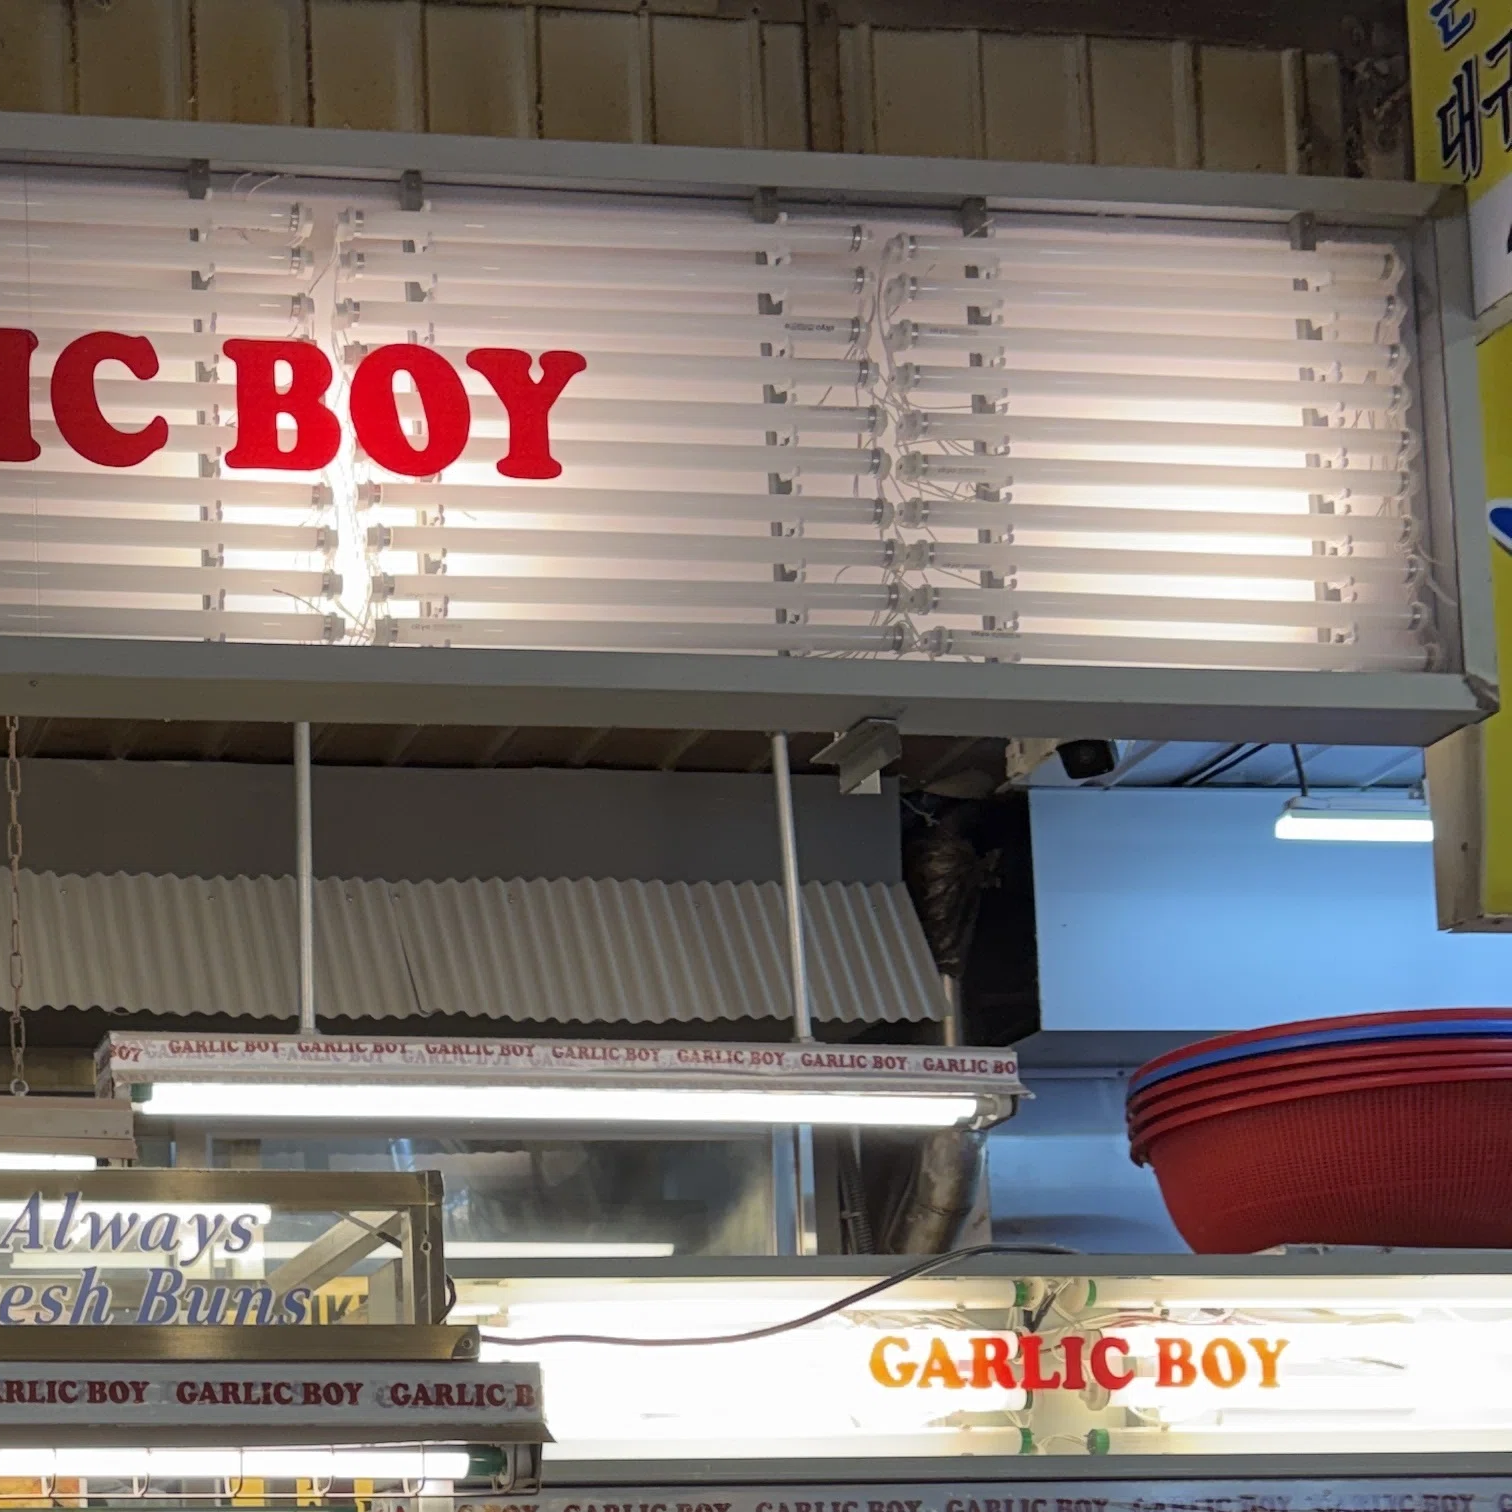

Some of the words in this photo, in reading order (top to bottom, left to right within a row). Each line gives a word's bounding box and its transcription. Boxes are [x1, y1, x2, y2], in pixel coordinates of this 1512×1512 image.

[223, 337, 588, 479] BOY
[168, 1040, 238, 1056] GARLIC
[245, 1039, 282, 1054] BOY
[372, 1042, 409, 1055] BOY
[500, 1044, 535, 1057] BOY
[551, 1046, 620, 1061] GARLIC
[625, 1048, 662, 1063] BOY
[677, 1048, 744, 1065] GARLIC
[750, 1052, 786, 1067] BOY
[800, 1053, 868, 1069] GARLIC
[872, 1056, 908, 1071] BOY
[923, 1057, 988, 1074] GARLIC
[992, 1060, 1017, 1075] BO
[137, 1267, 312, 1326] Buns
[870, 1335, 1136, 1391] GARLIC
[1157, 1336, 1291, 1390] BOY
[88, 1381, 151, 1404] BOY
[176, 1381, 293, 1405] GARLIC
[302, 1382, 364, 1406] BOY
[391, 1383, 507, 1407] GARLIC
